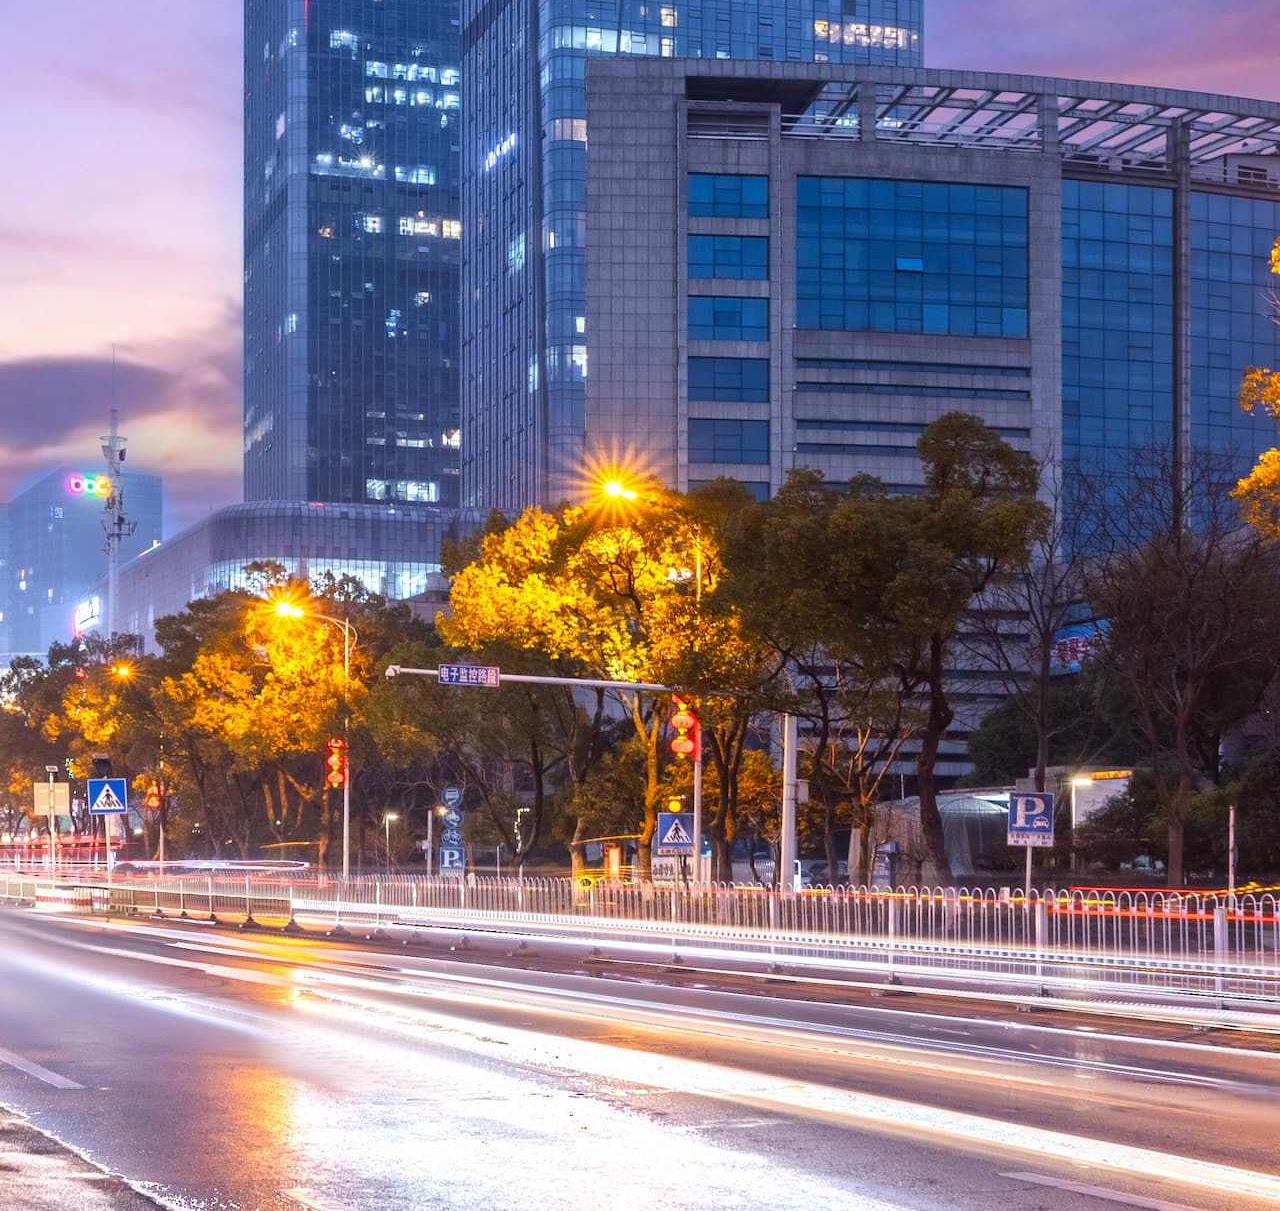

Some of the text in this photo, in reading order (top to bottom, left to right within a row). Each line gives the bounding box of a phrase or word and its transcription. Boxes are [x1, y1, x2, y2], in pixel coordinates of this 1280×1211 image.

[440, 666, 497, 684] 电子监控路段
[1011, 796, 1045, 828] P
[441, 849, 460, 868] P
